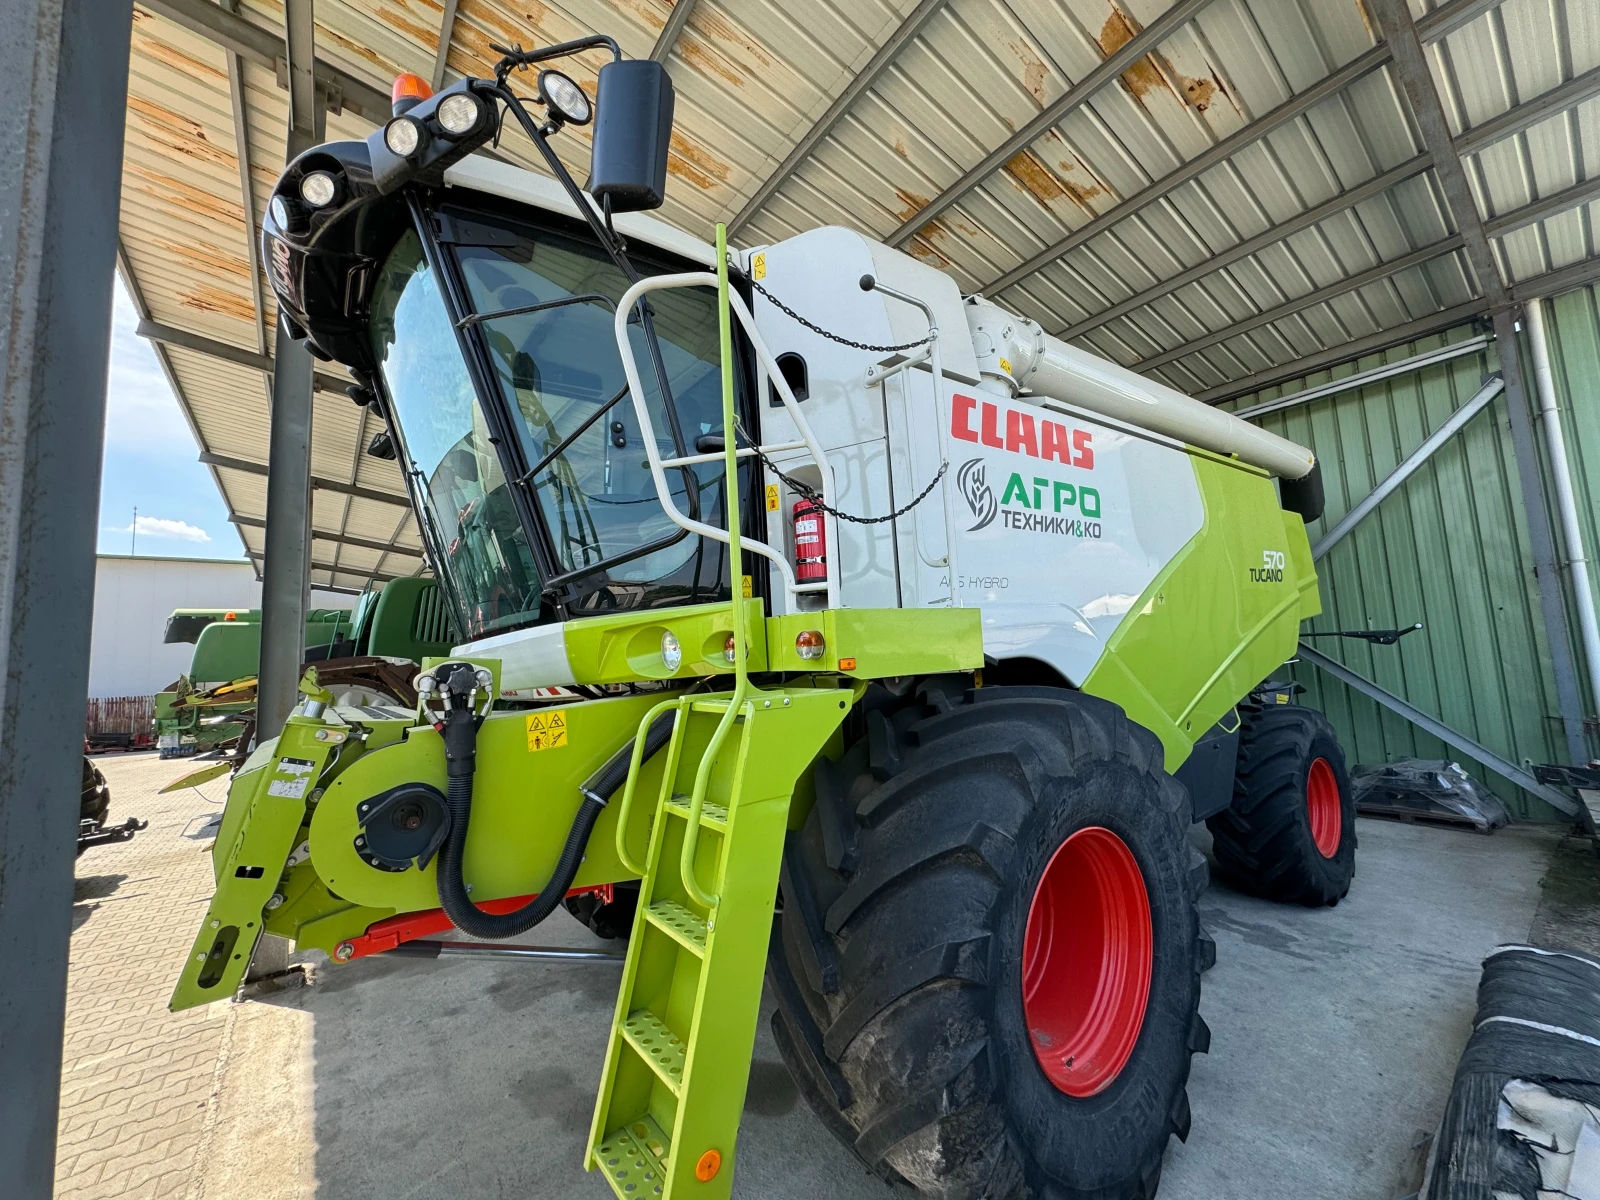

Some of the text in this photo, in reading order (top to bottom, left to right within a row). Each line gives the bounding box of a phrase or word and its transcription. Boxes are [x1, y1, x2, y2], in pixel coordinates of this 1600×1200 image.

[951, 393, 1094, 470] CLAAS
[1000, 472, 1101, 518] АГРО
[1263, 551, 1284, 569] 570
[939, 575, 1009, 589] AS HYBRID
[1249, 568, 1282, 582] TUCANO
